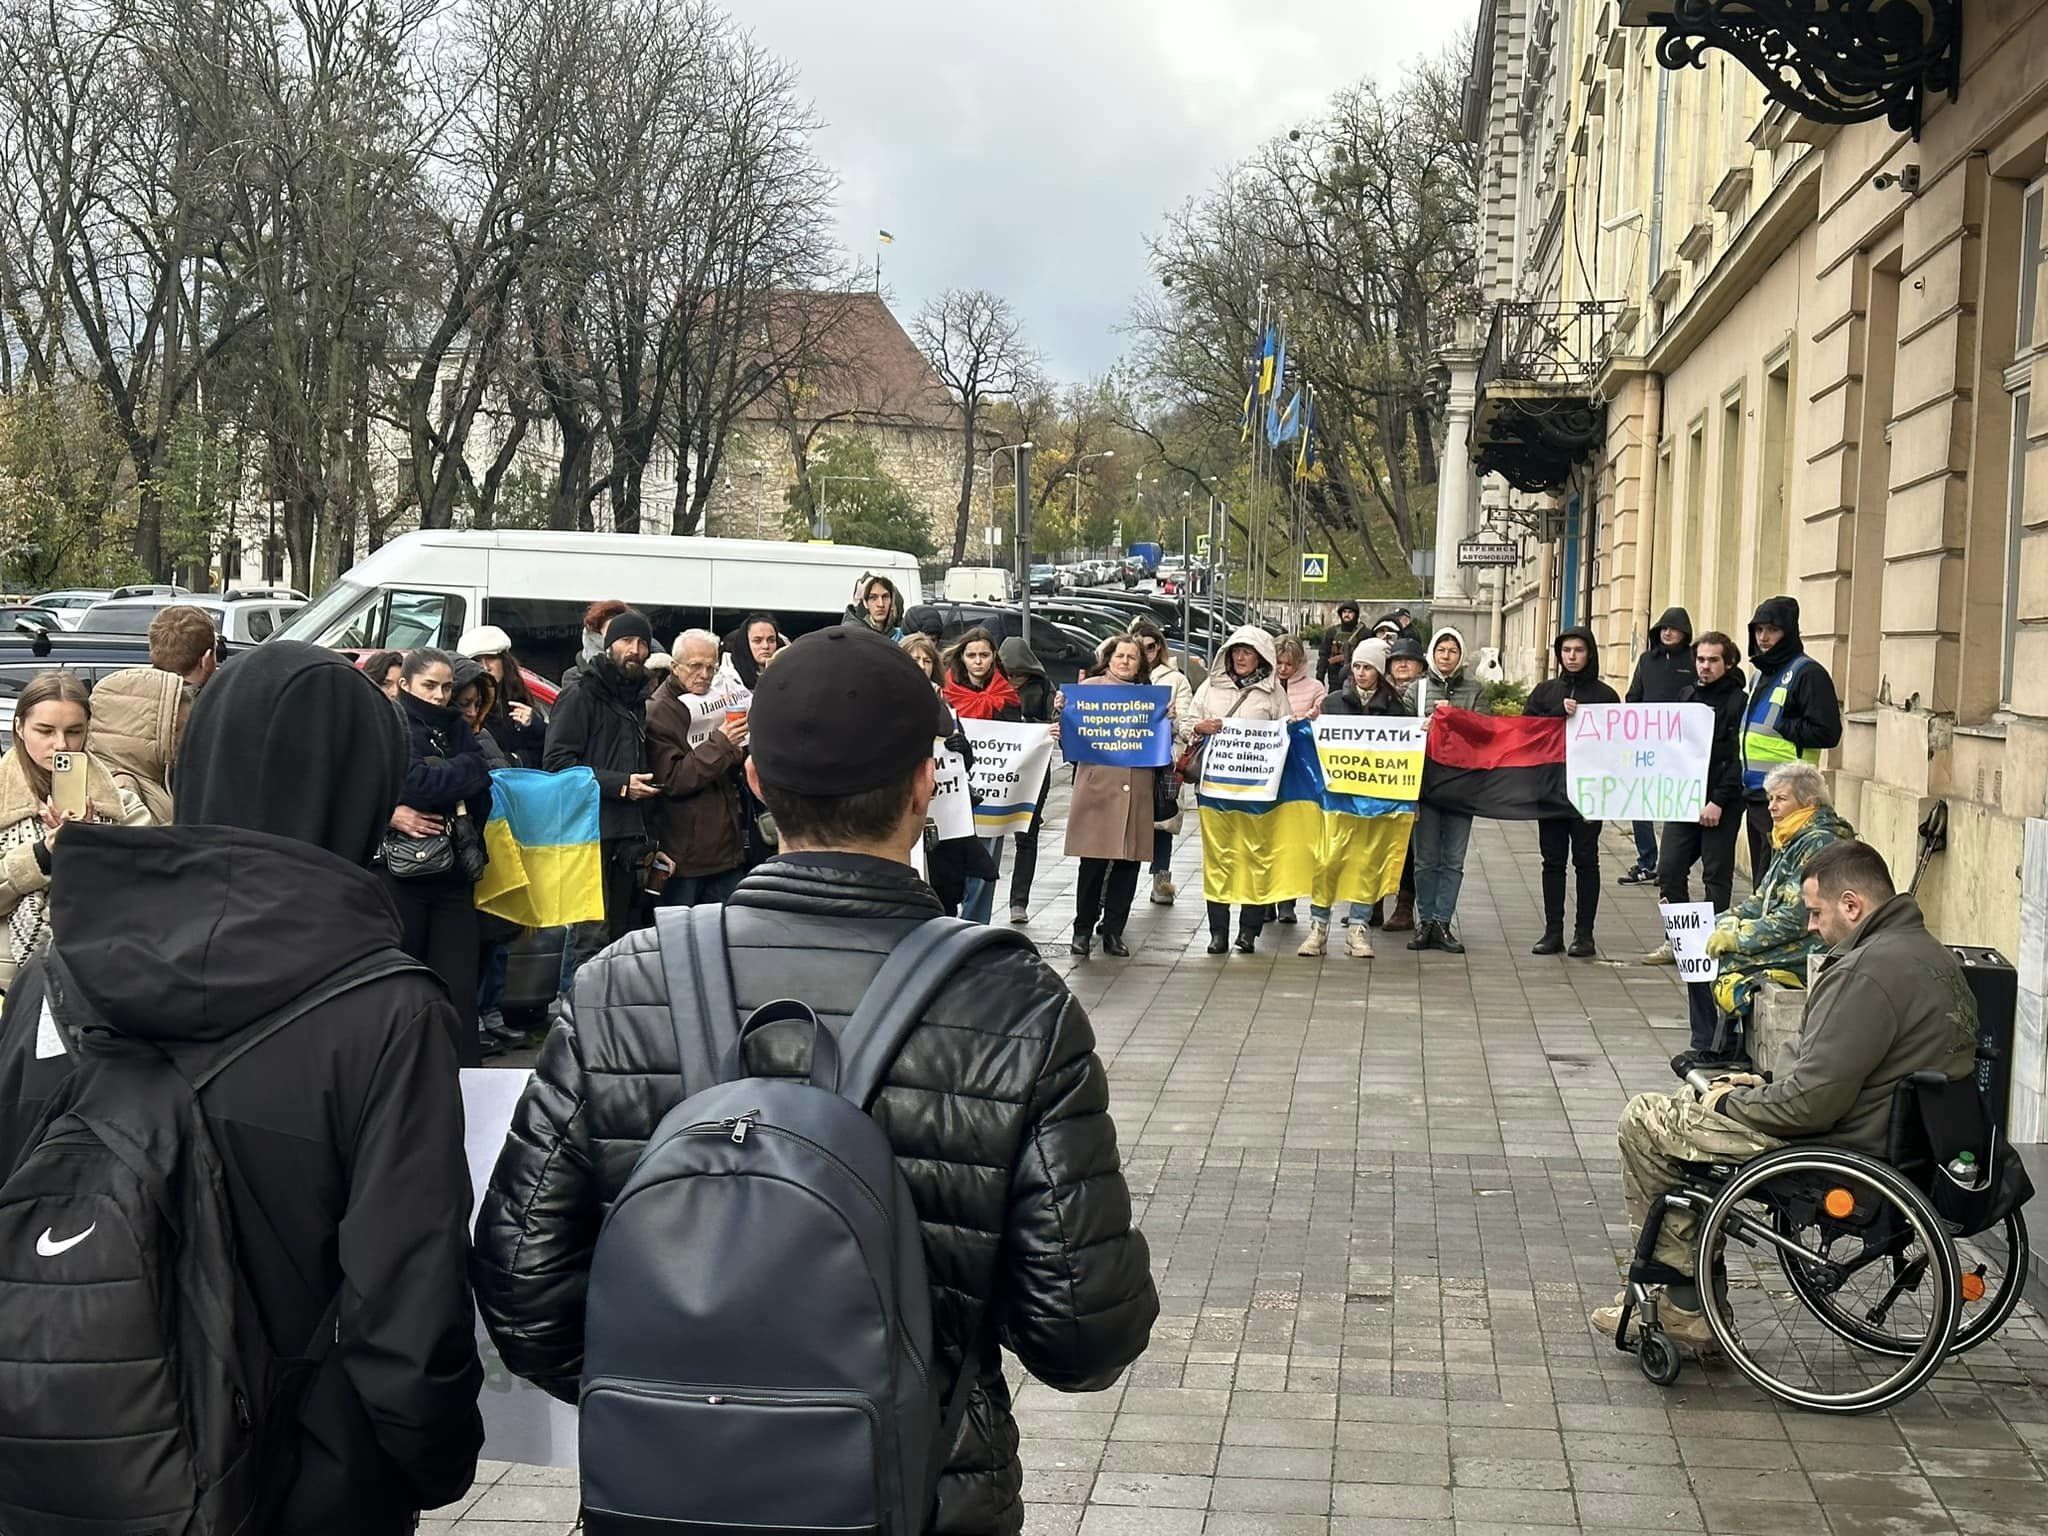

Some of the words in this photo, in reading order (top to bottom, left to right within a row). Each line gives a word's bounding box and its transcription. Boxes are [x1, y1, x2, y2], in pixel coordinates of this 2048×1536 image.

[1077, 700, 1099, 711] Нам
[1102, 700, 1154, 712] потрібна
[1083, 714, 1148, 725] перемога!!!
[1575, 709, 1682, 742] ДРОНИ
[1078, 727, 1110, 737] Потім
[1114, 726, 1154, 738] будуть
[1216, 726, 1242, 735] обіть
[1318, 728, 1410, 742] ДЕПУТАТИ
[970, 739, 1022, 752] добути
[1091, 741, 1142, 751] стадіони
[974, 756, 1007, 768] могу
[1329, 755, 1370, 767] ПОРА
[1375, 758, 1408, 769] ВАМ
[980, 771, 1020, 783] треба
[1576, 774, 1702, 819] БРУКІВКА
